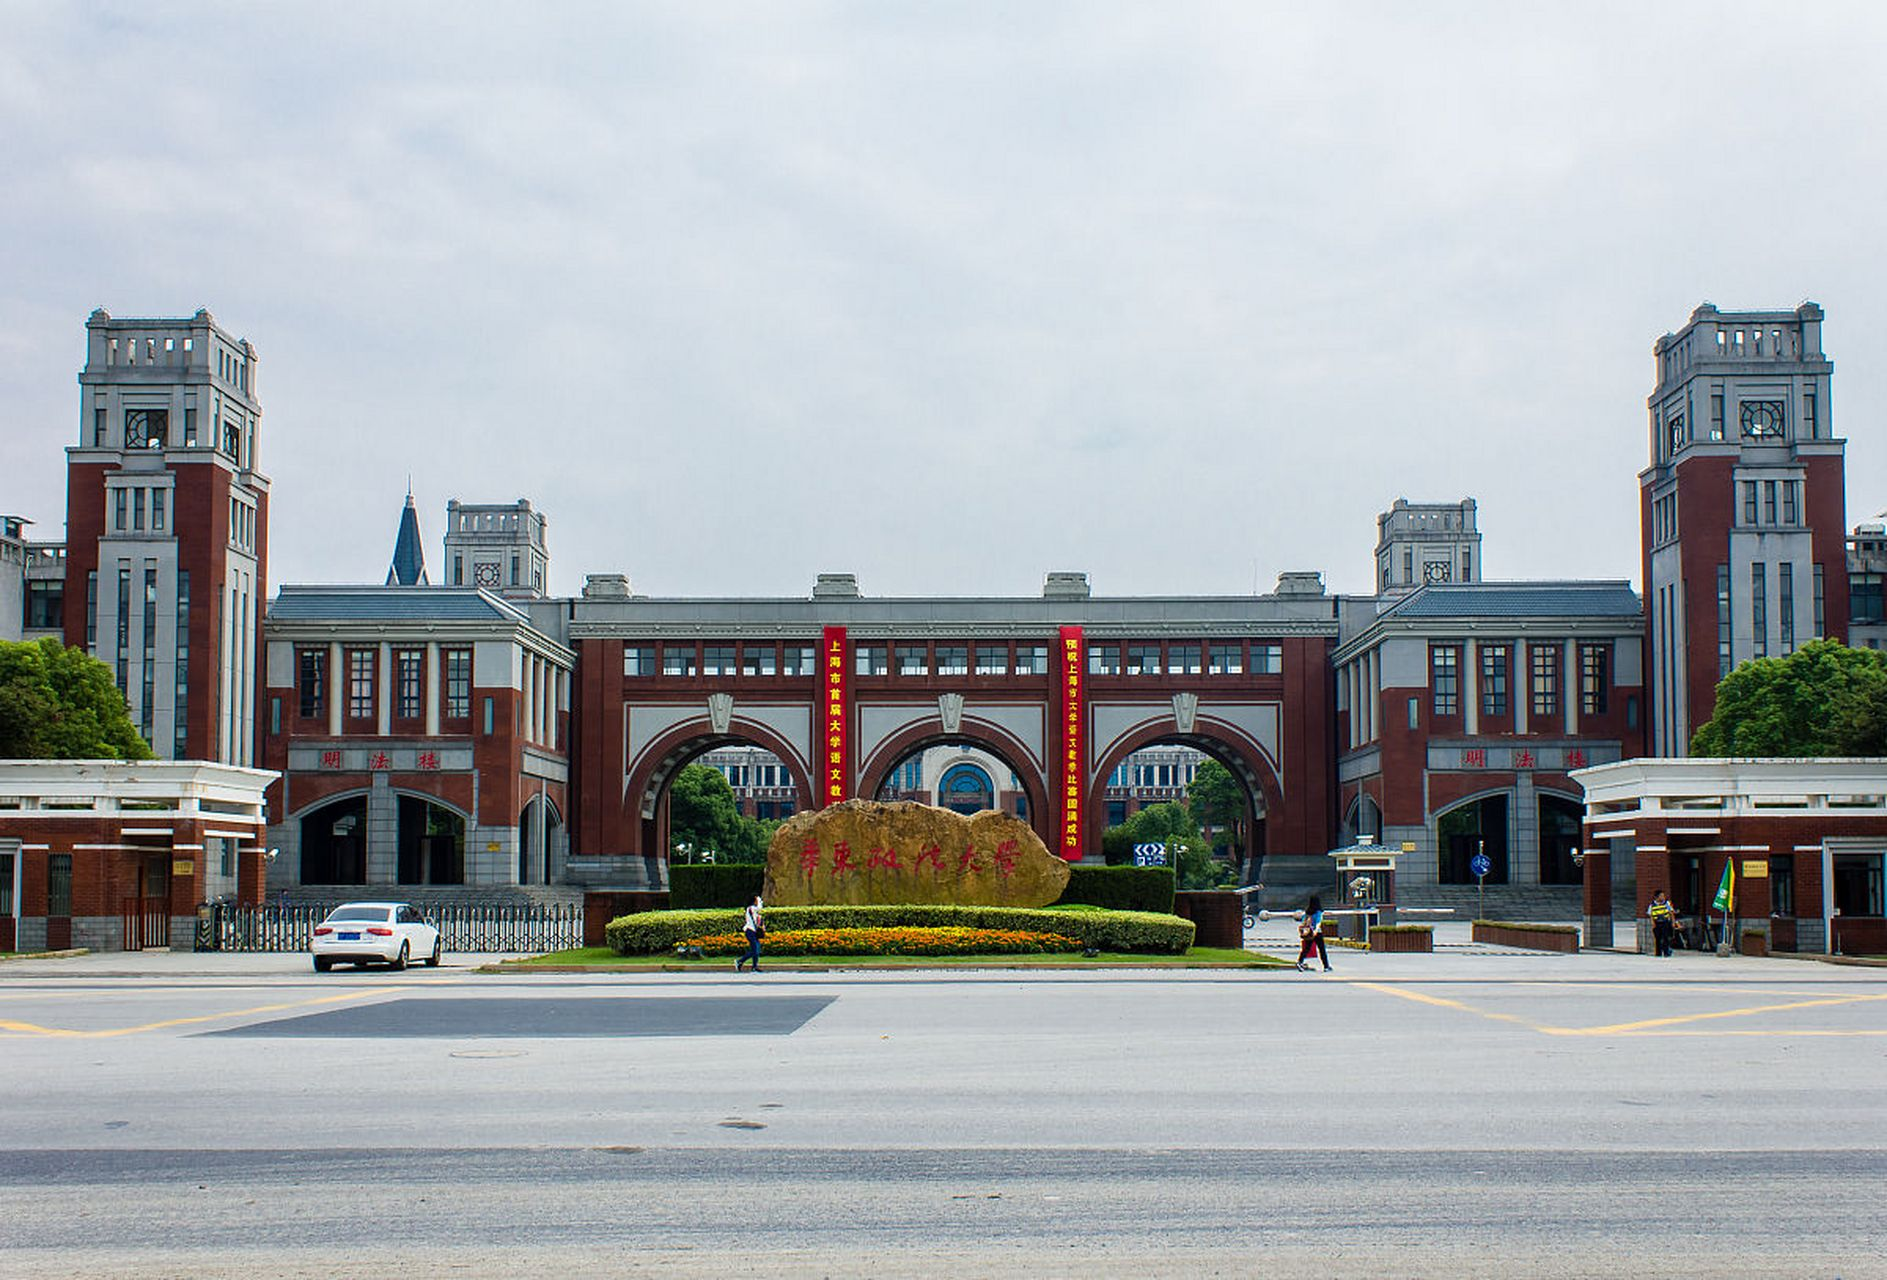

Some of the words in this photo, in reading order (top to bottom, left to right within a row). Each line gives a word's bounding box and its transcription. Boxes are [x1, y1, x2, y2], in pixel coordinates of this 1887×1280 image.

[321, 750, 439, 769] 明法楼
[829, 639, 841, 804] 上海市首届大学语文教
